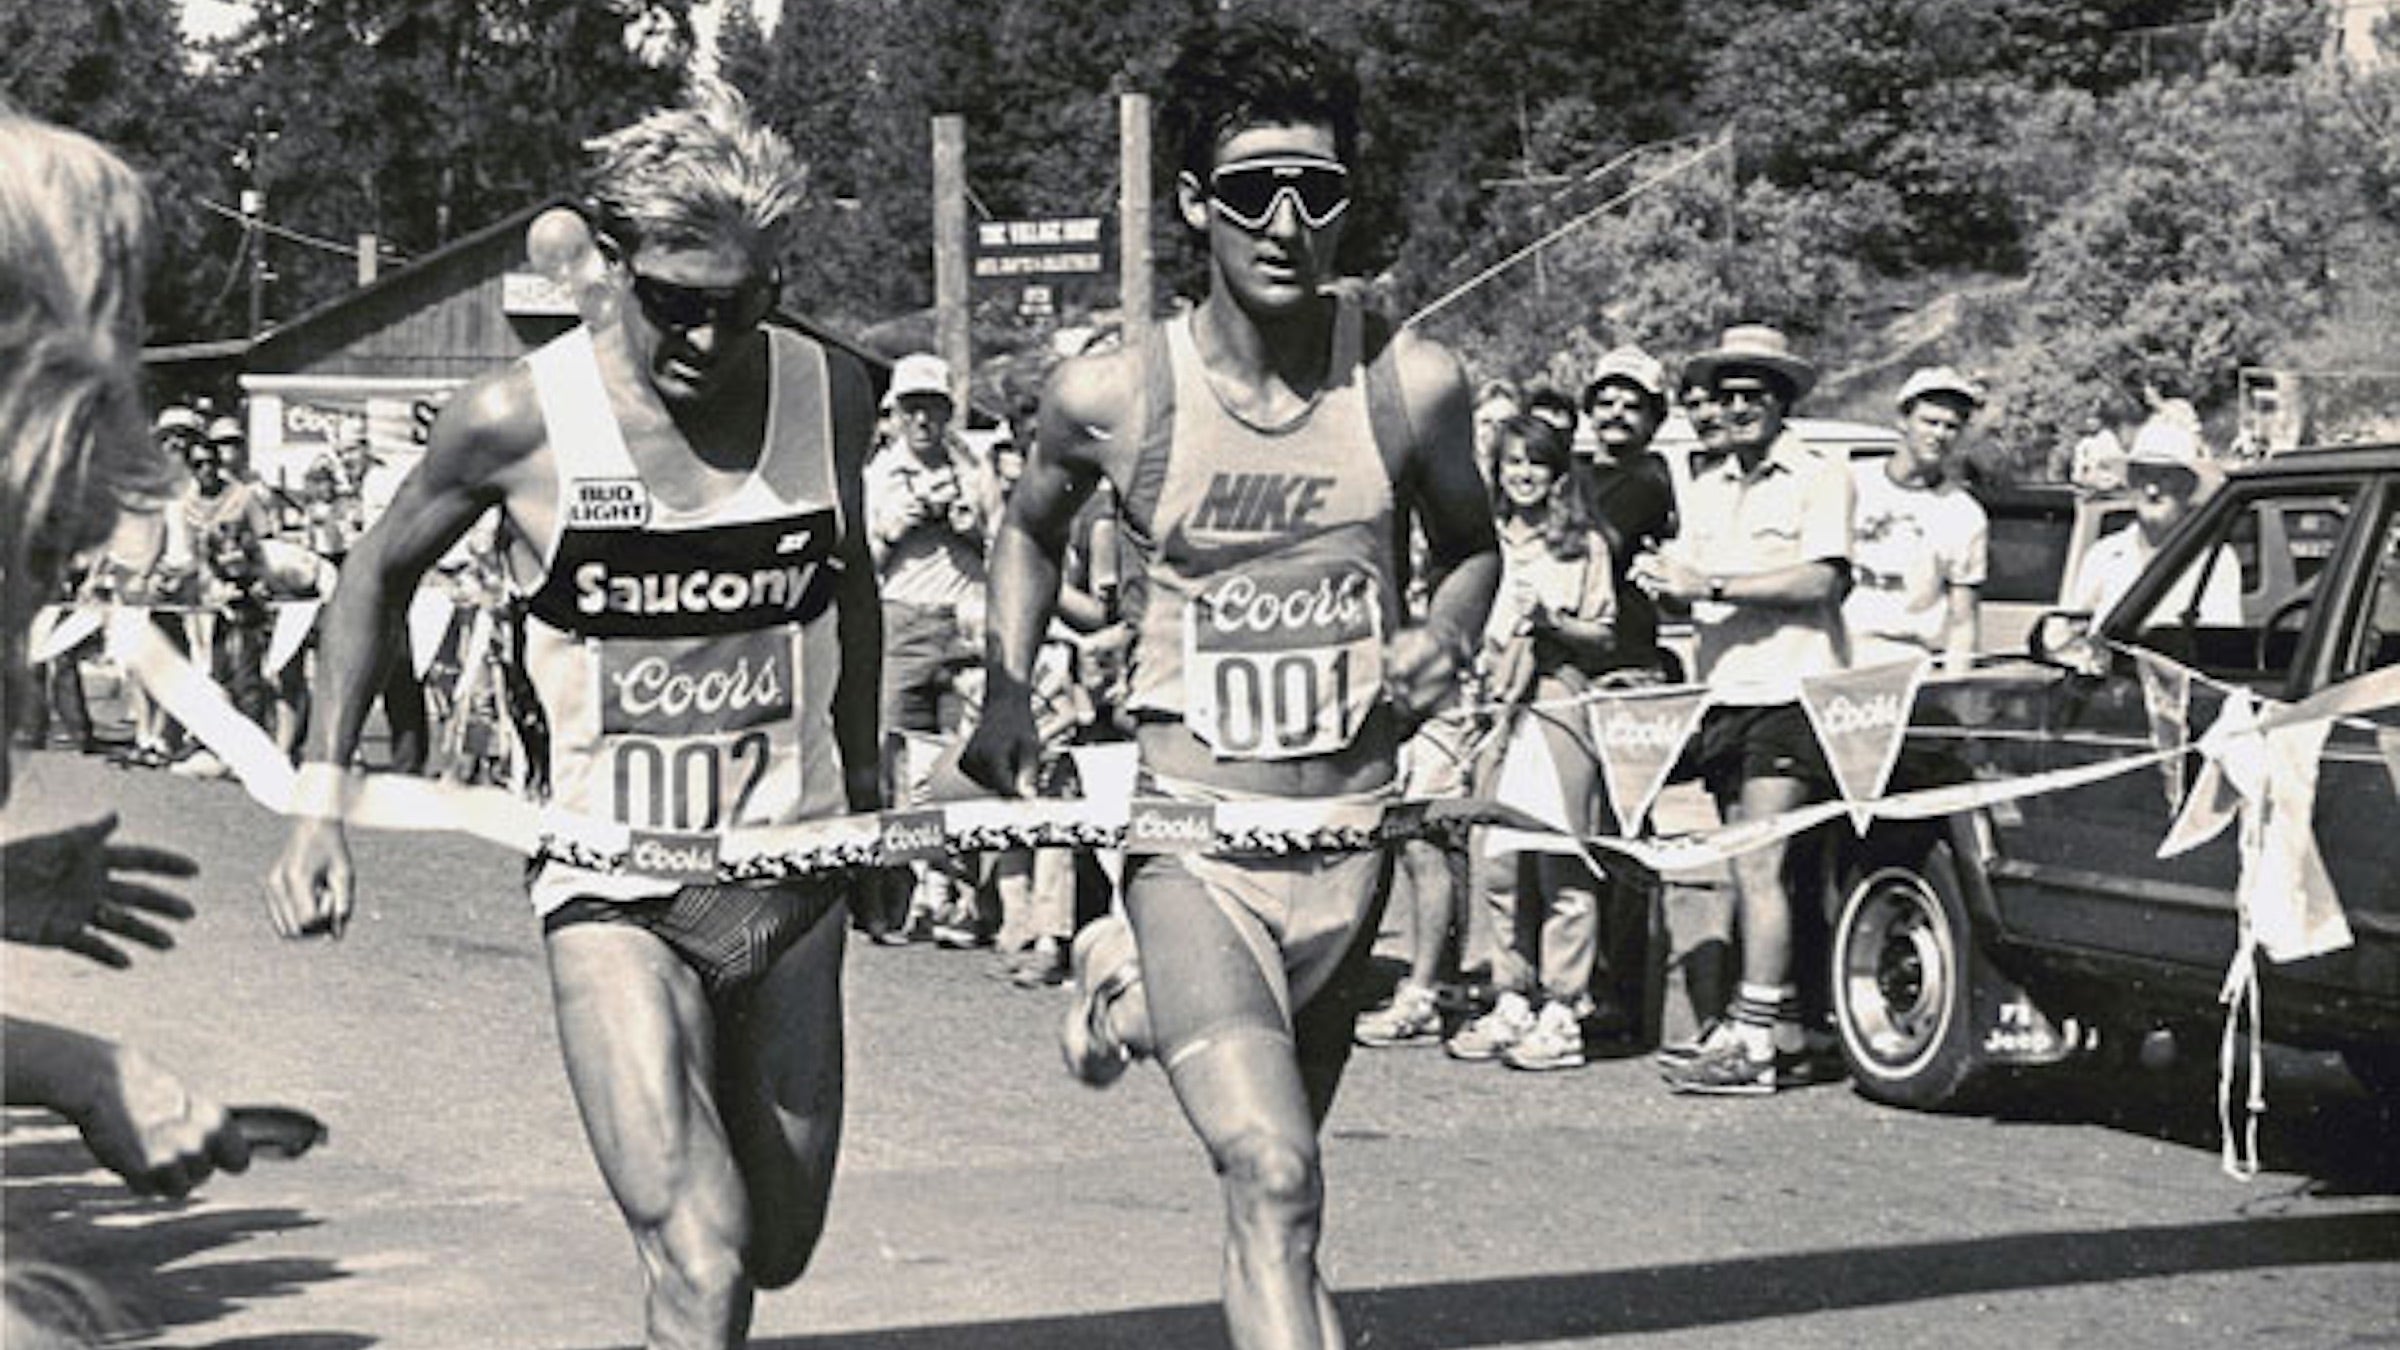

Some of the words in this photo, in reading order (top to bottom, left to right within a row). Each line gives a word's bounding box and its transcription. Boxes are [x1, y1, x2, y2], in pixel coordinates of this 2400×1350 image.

[570, 505, 641, 520] LIGHT
[580, 486, 633, 501] BUD
[1190, 473, 1337, 531] NIKE
[576, 561, 818, 614] Saucony
[1205, 574, 1366, 632] Coors
[612, 655, 782, 716] Coors
[1215, 650, 1350, 752] 001
[614, 731, 771, 829] 002
[1137, 809, 1209, 839] Coors
[633, 840, 713, 871] Coors
